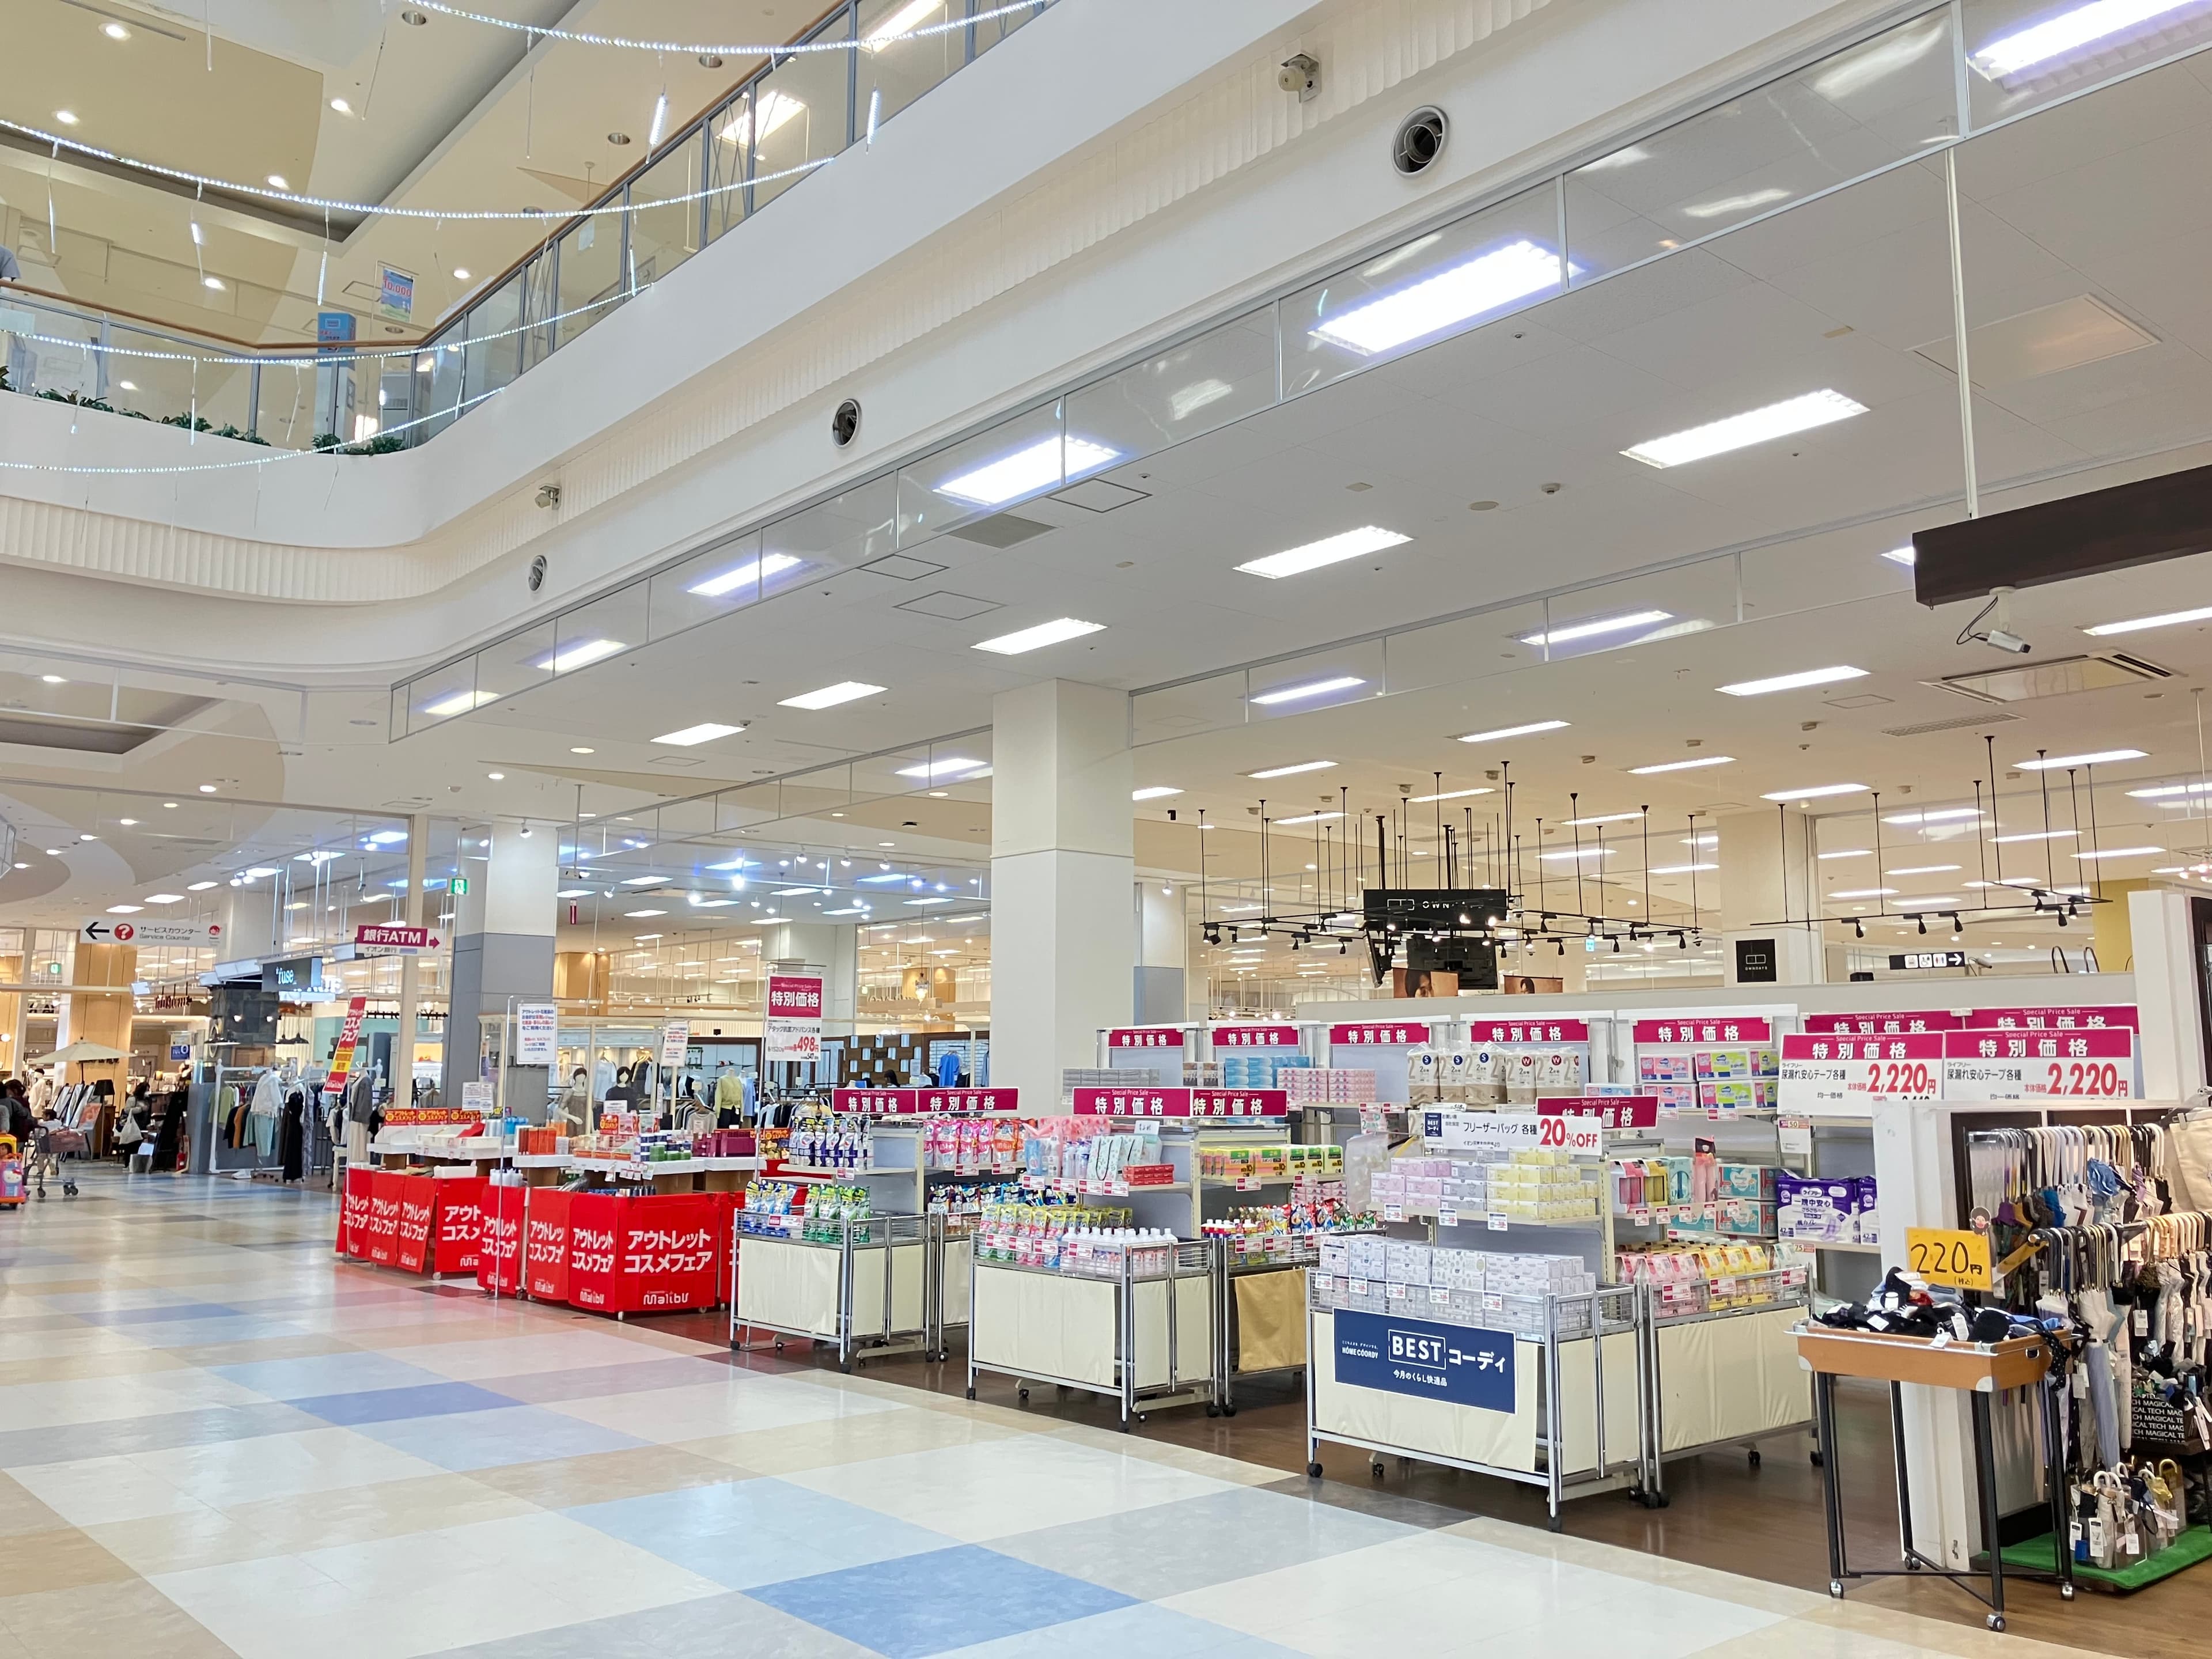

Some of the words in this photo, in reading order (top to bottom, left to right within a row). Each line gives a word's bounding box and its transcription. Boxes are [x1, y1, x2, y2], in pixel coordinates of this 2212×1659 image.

[140, 926, 201, 934] サービスカウンター
[363, 928, 421, 944] 銀行ATM
[771, 991, 819, 1007] 特別価格
[344, 1017, 362, 1029] コスメ
[1834, 1020, 1926, 1033] 特別価格
[1997, 1015, 2106, 1029] 特別価格
[341, 1029, 358, 1041] フェア
[1122, 1035, 1167, 1046] 特別価格
[1228, 1032, 1279, 1046] 特別価格
[1348, 1029, 1407, 1044] 特別価格
[1492, 1027, 1562, 1041] 特別価格
[1658, 1025, 1739, 1042] 特別価格
[1812, 1043, 1907, 1060] 特別価格
[1979, 1039, 2088, 1058] 特別価格
[1782, 1069, 1846, 1080] 尿漏れ安心テープ各種
[1847, 1082, 1867, 1091] 本体価格
[1867, 1063, 1936, 1094] 2,220円
[1947, 1069, 2021, 1081] 尿漏れ安心テープ各種
[2024, 1084, 2047, 1093] 本体価格
[2047, 1063, 2128, 1097] 2,220円
[848, 1096, 897, 1112] 特別価格
[930, 1095, 995, 1111] 特別価格
[1095, 1096, 1164, 1115] 特別価格
[1193, 1098, 1263, 1116] 特別価格
[1463, 1122, 1518, 1134] フリーザーバッグ
[1521, 1124, 1537, 1135] 各種
[1540, 1118, 1597, 1148] 20%OFF
[573, 1228, 613, 1251] アウトレット
[628, 1228, 711, 1251] アウトレット
[572, 1251, 614, 1273] コスメフェア
[624, 1251, 713, 1274] コスメフェア
[1911, 1241, 1982, 1275] 220円
[643, 1292, 689, 1305] Malibu
[1392, 1335, 1442, 1362] BEST
[1448, 1349, 1506, 1373] コーディ
[1393, 1369, 1448, 1387] 今月のくらし快適品
[2144, 1415, 2176, 1423] MAGICAL
[2146, 1430, 2176, 1438] MAGICAL
